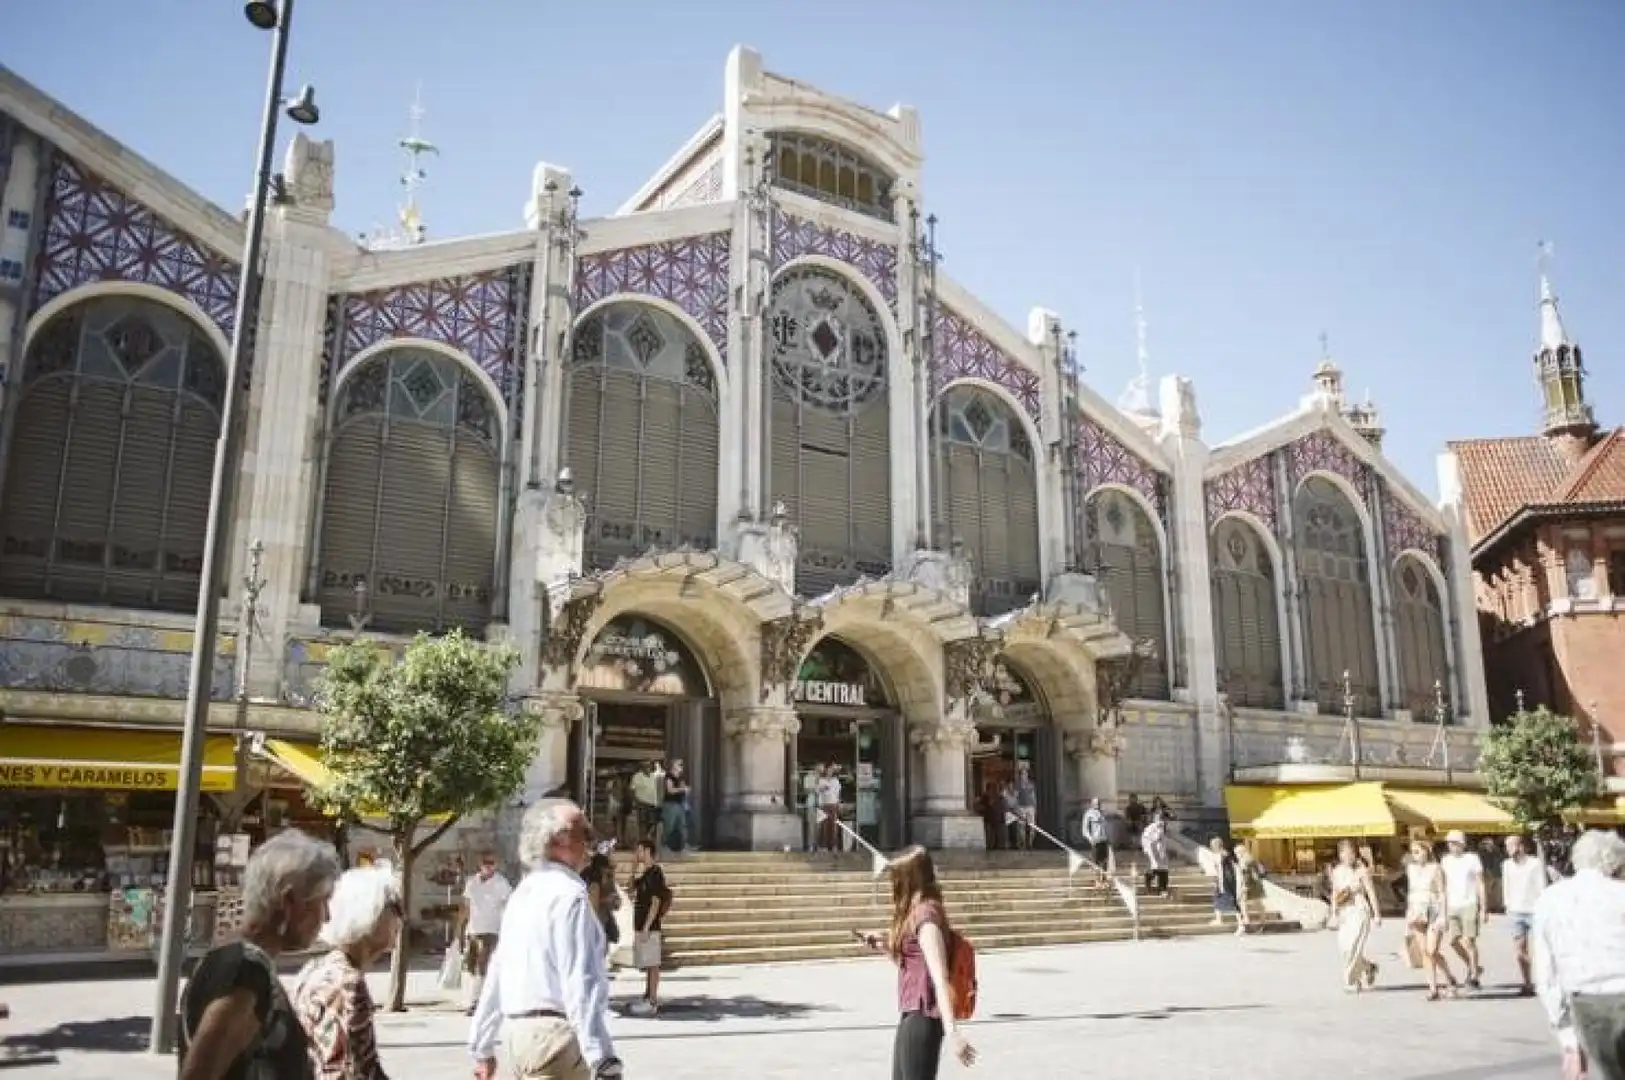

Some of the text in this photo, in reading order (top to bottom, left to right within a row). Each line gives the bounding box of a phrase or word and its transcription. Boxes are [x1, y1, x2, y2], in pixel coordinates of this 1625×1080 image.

[807, 680, 867, 705] CENTRAL
[40, 766, 52, 783] Y
[58, 767, 167, 786] CARAMELOS
